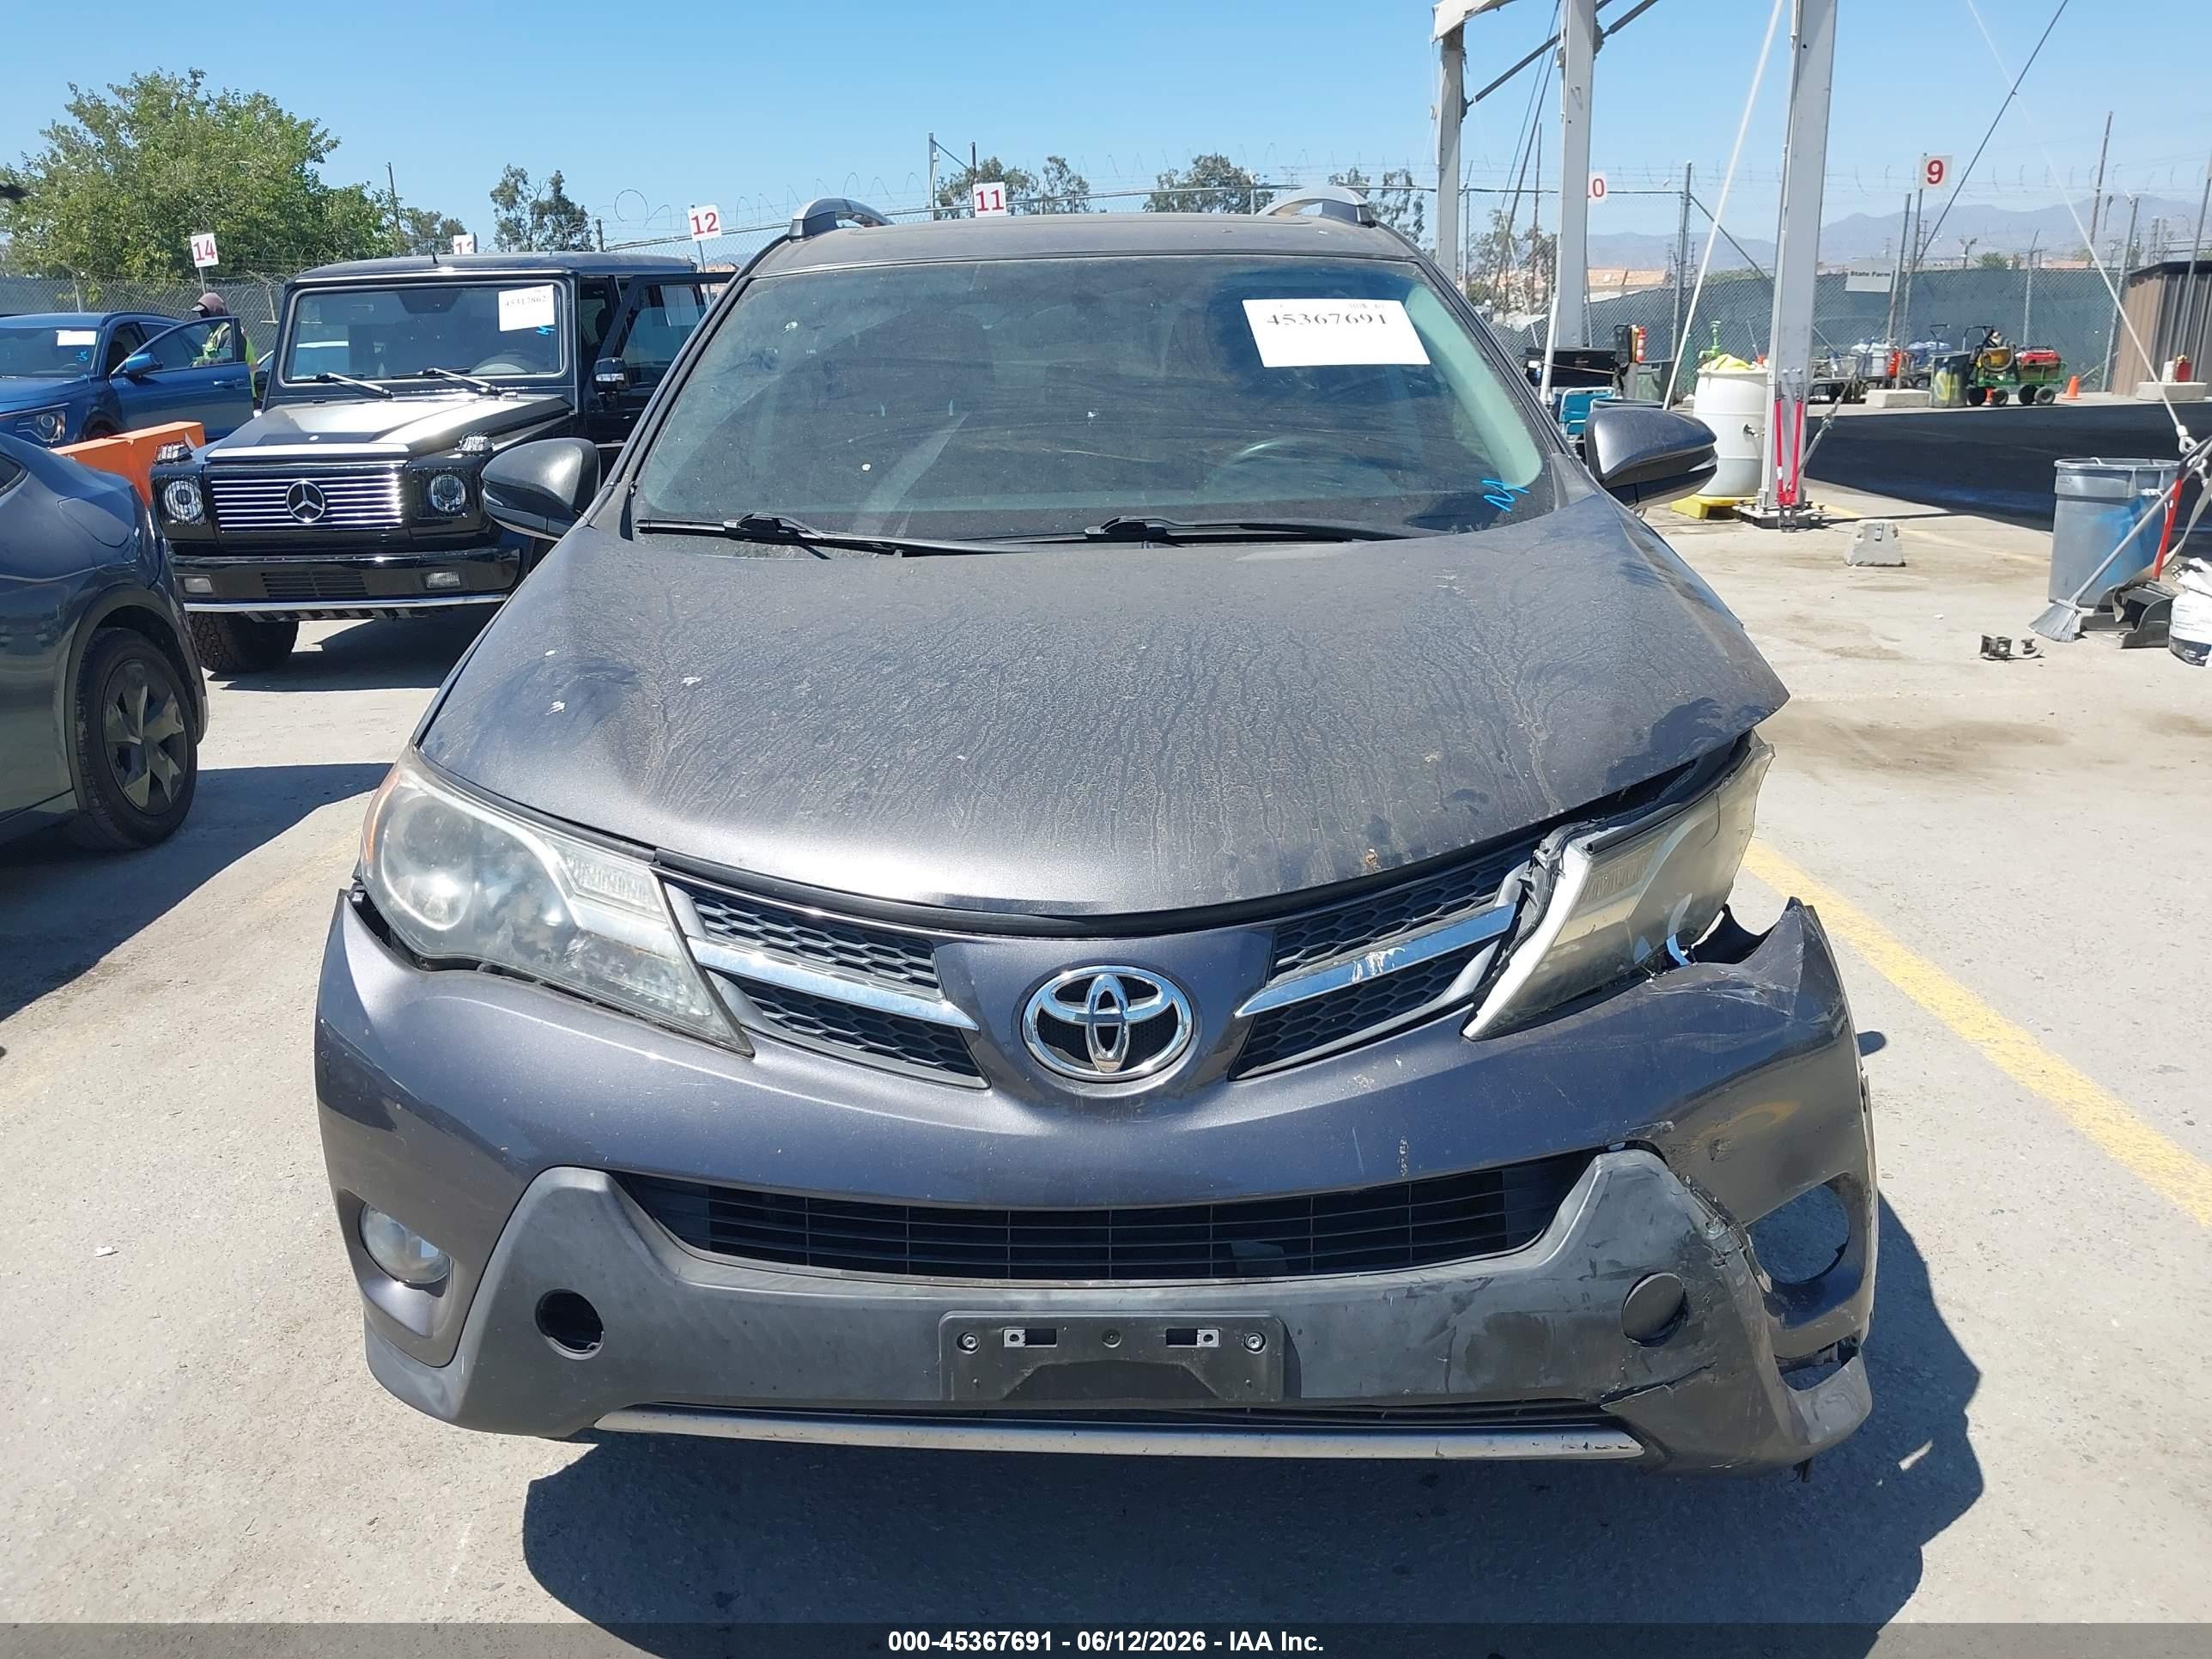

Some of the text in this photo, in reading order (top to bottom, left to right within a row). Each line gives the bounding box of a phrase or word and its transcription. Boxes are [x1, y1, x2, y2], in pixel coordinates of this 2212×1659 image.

[1927, 160, 1944, 185] 9
[975, 189, 1005, 212] 11
[690, 212, 719, 235] 12
[192, 240, 216, 262] 14
[1266, 313, 1388, 326] 45367691
